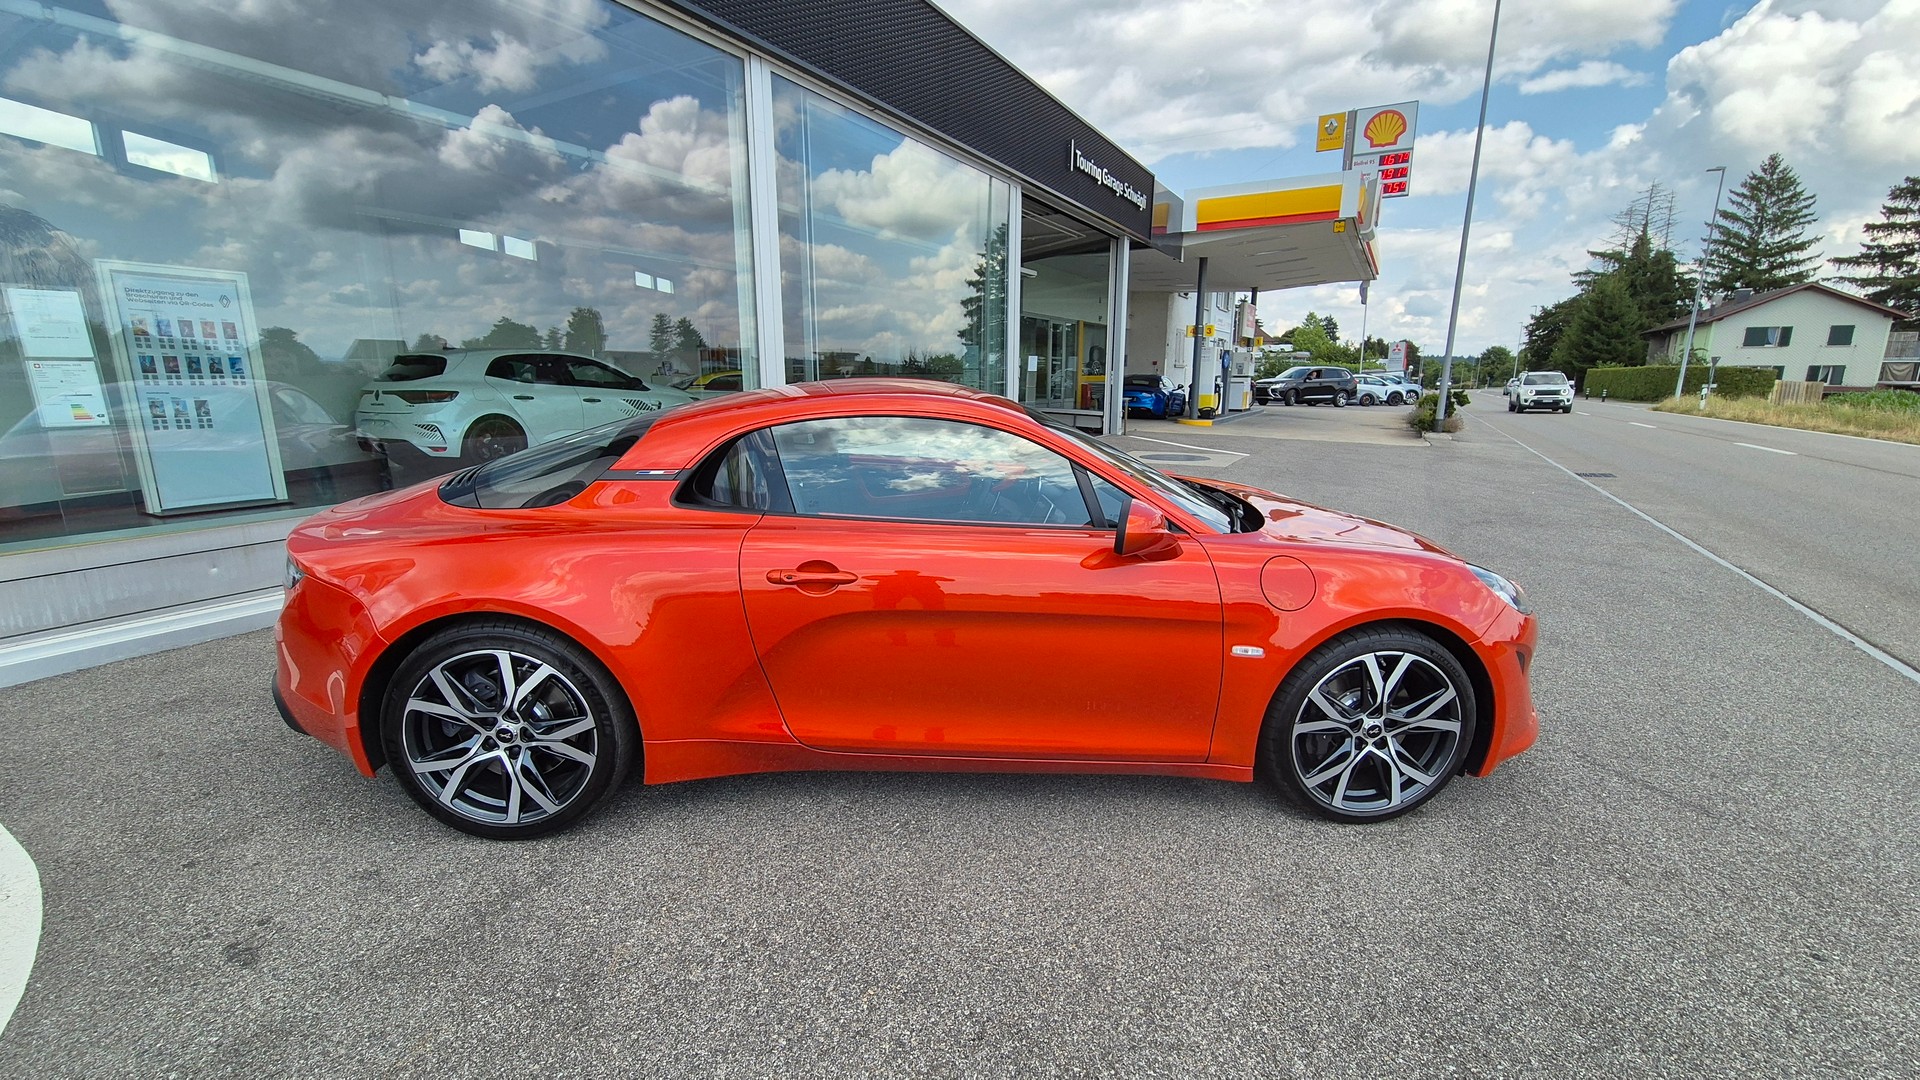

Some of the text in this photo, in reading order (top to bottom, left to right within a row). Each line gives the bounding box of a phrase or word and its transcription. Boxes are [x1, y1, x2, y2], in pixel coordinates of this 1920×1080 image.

[1075, 149, 1102, 185] Touring
[1102, 168, 1124, 197] Garage
[124, 287, 174, 297] Direktzugang
[1206, 327, 1212, 335] 3
